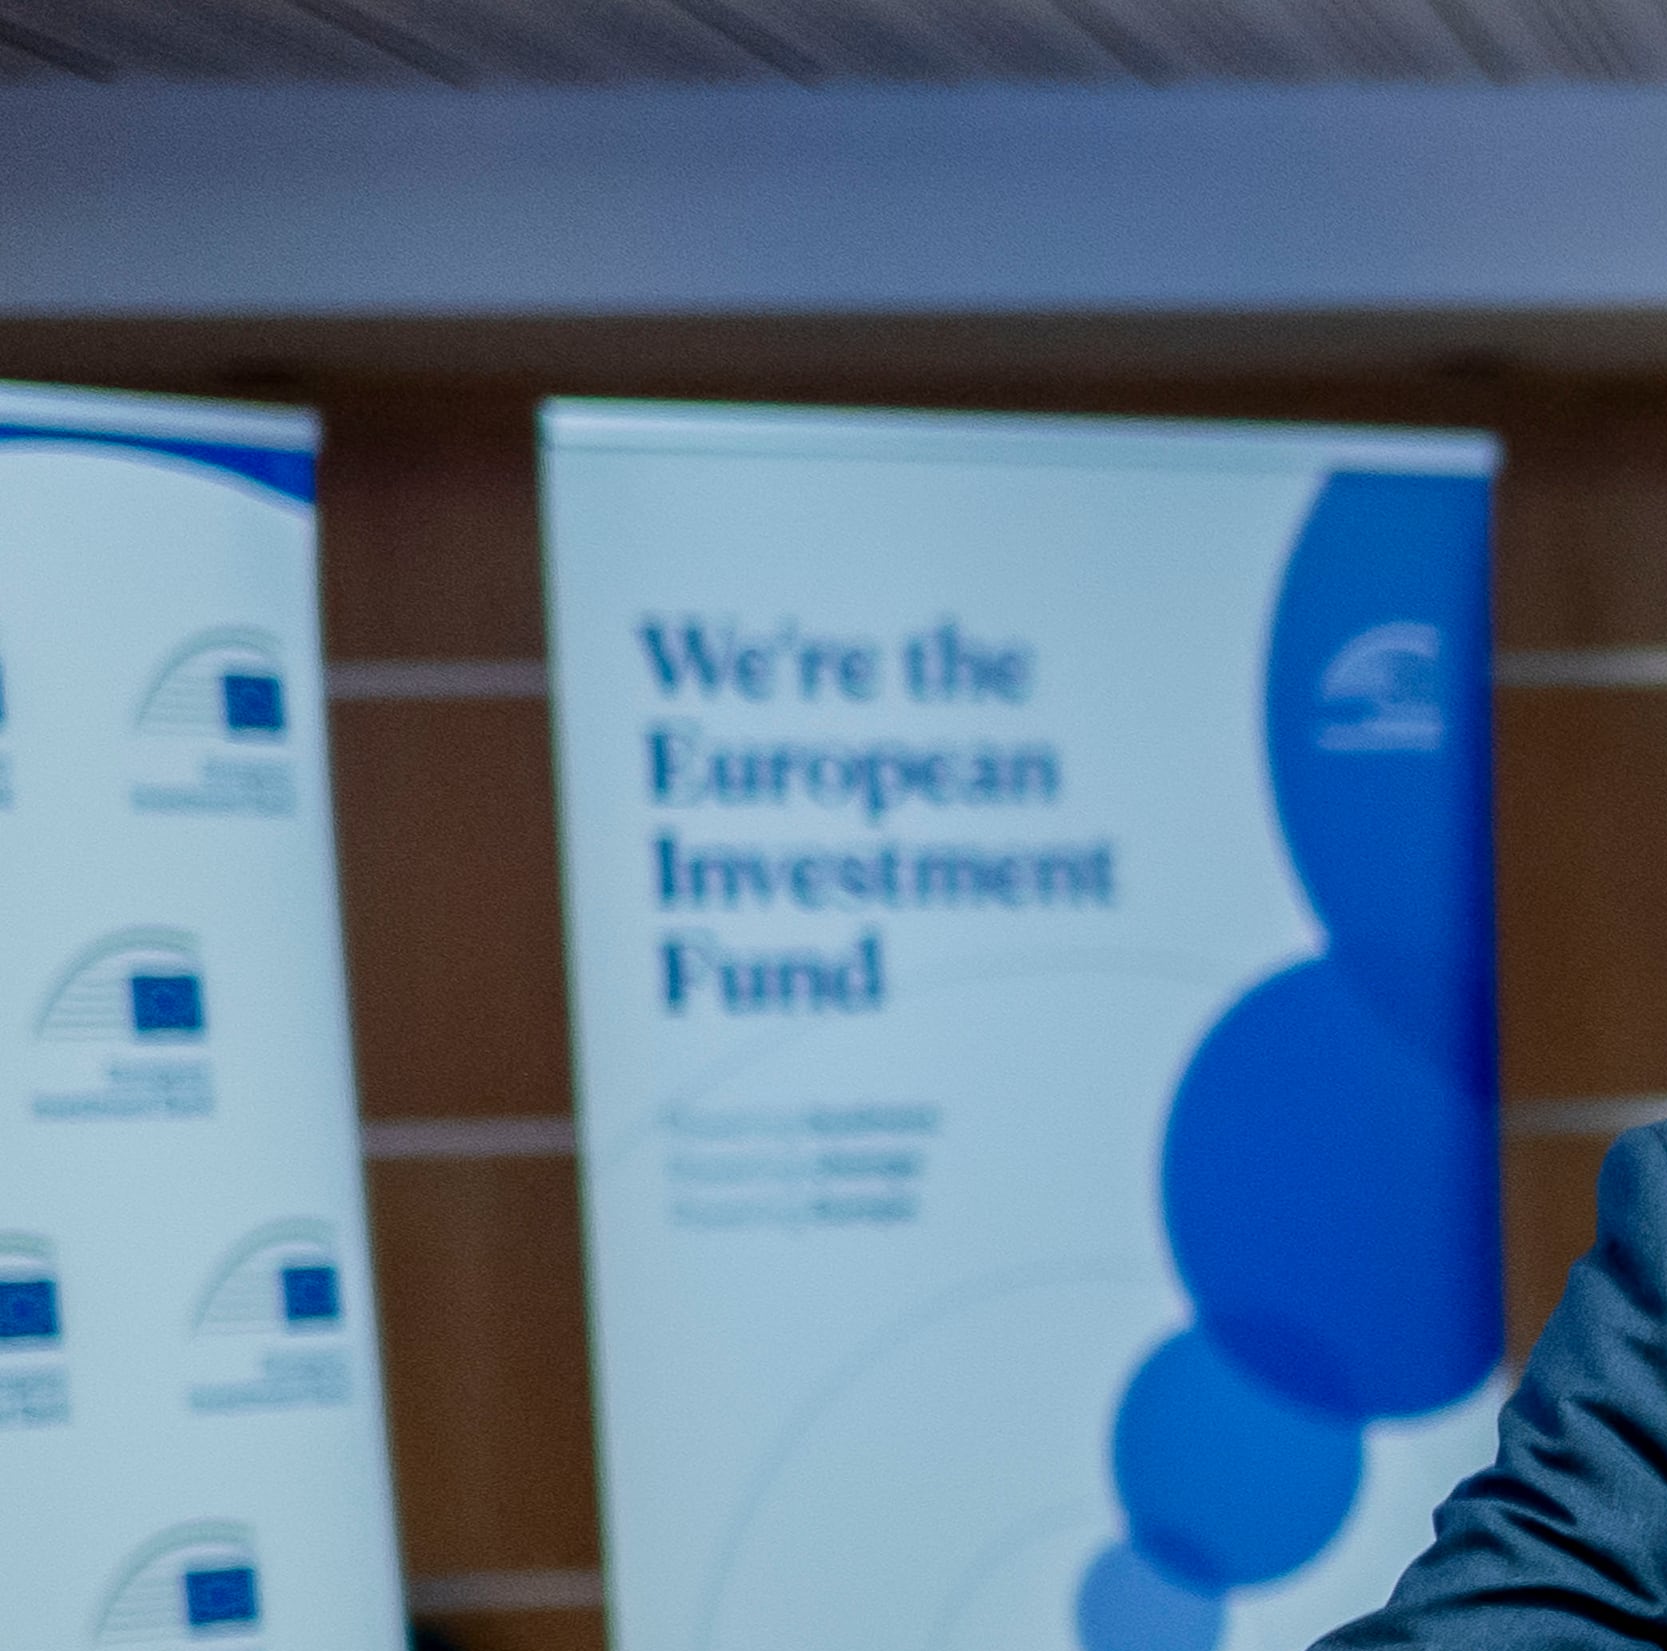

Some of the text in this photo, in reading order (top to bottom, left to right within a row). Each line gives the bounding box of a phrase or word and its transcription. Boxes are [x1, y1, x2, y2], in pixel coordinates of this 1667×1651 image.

[636, 615, 1032, 701] We're the
[646, 720, 1060, 822] European
[652, 829, 1113, 910] Investment
[661, 927, 883, 1015] Fund
